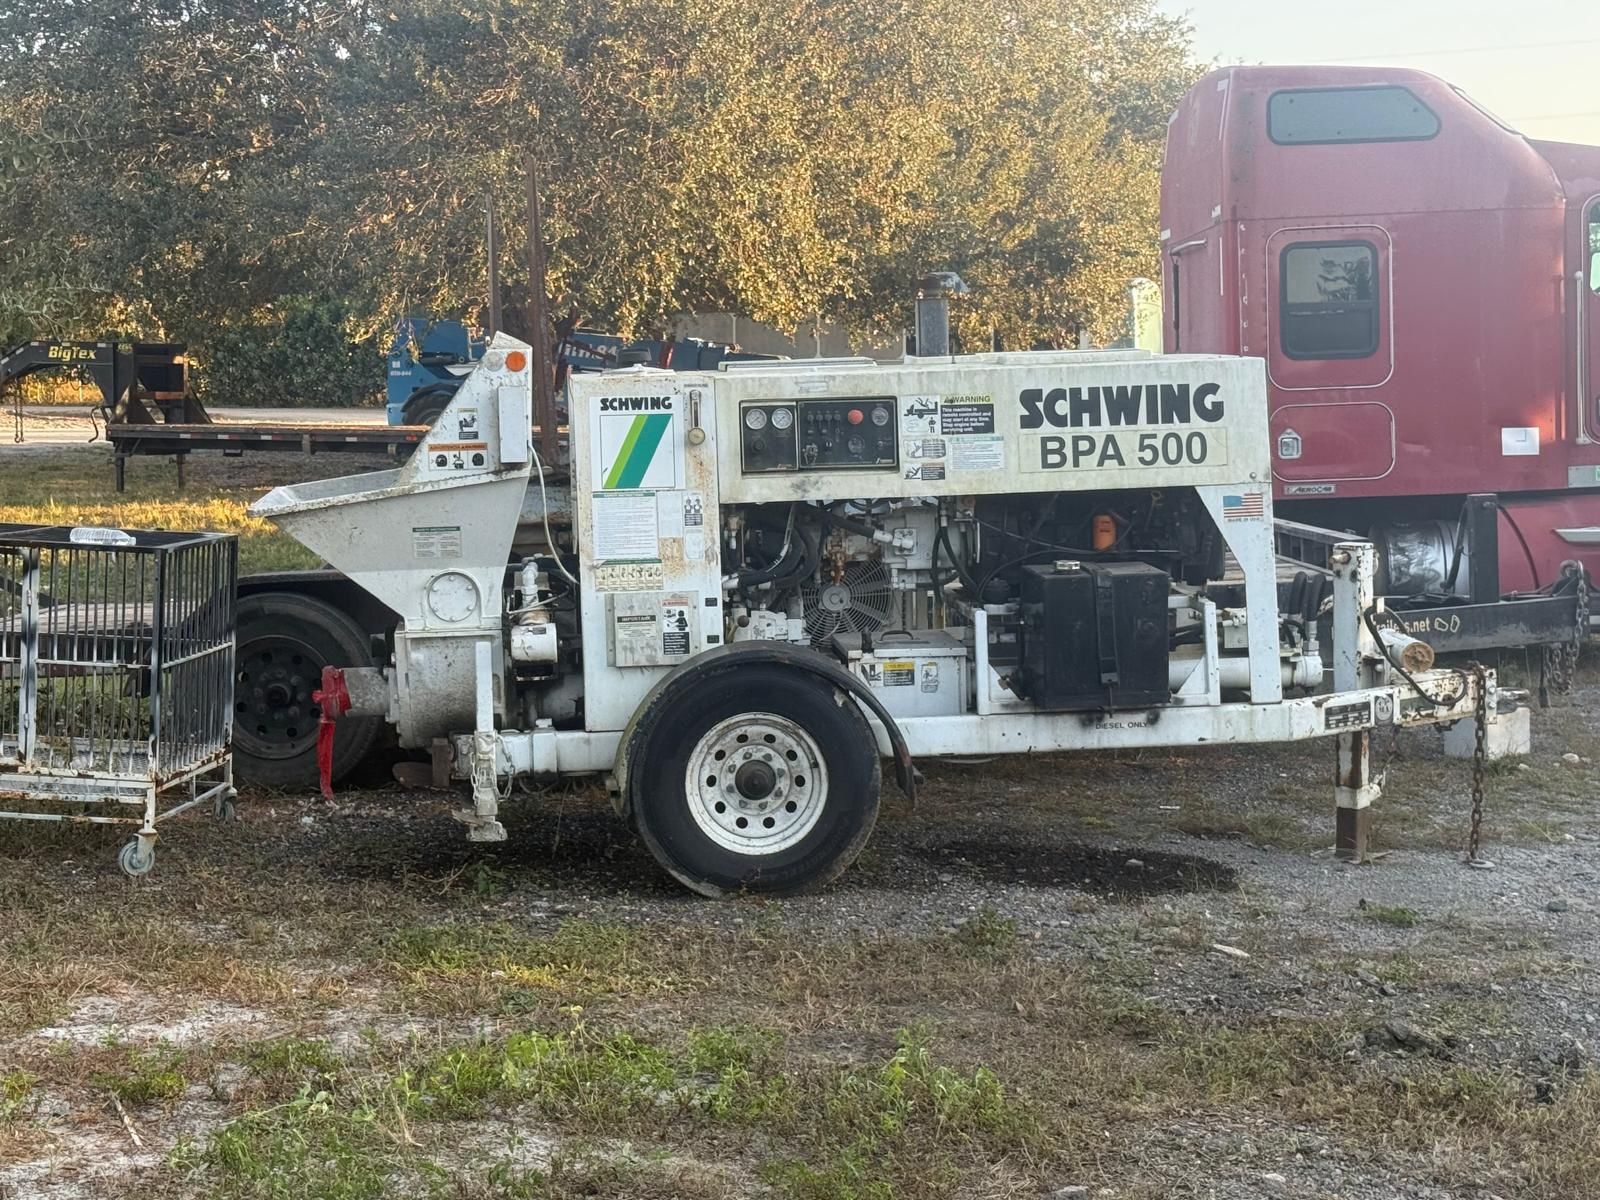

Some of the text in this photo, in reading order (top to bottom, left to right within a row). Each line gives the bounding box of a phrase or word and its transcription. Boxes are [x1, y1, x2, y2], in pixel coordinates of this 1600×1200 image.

[48, 346, 97, 361] BigTex
[600, 396, 672, 411] SCHWING
[1019, 382, 1225, 429] SCHWING
[1040, 434, 1126, 469] BPA
[1137, 431, 1208, 466] 500
[1095, 721, 1125, 730] DIESEL
